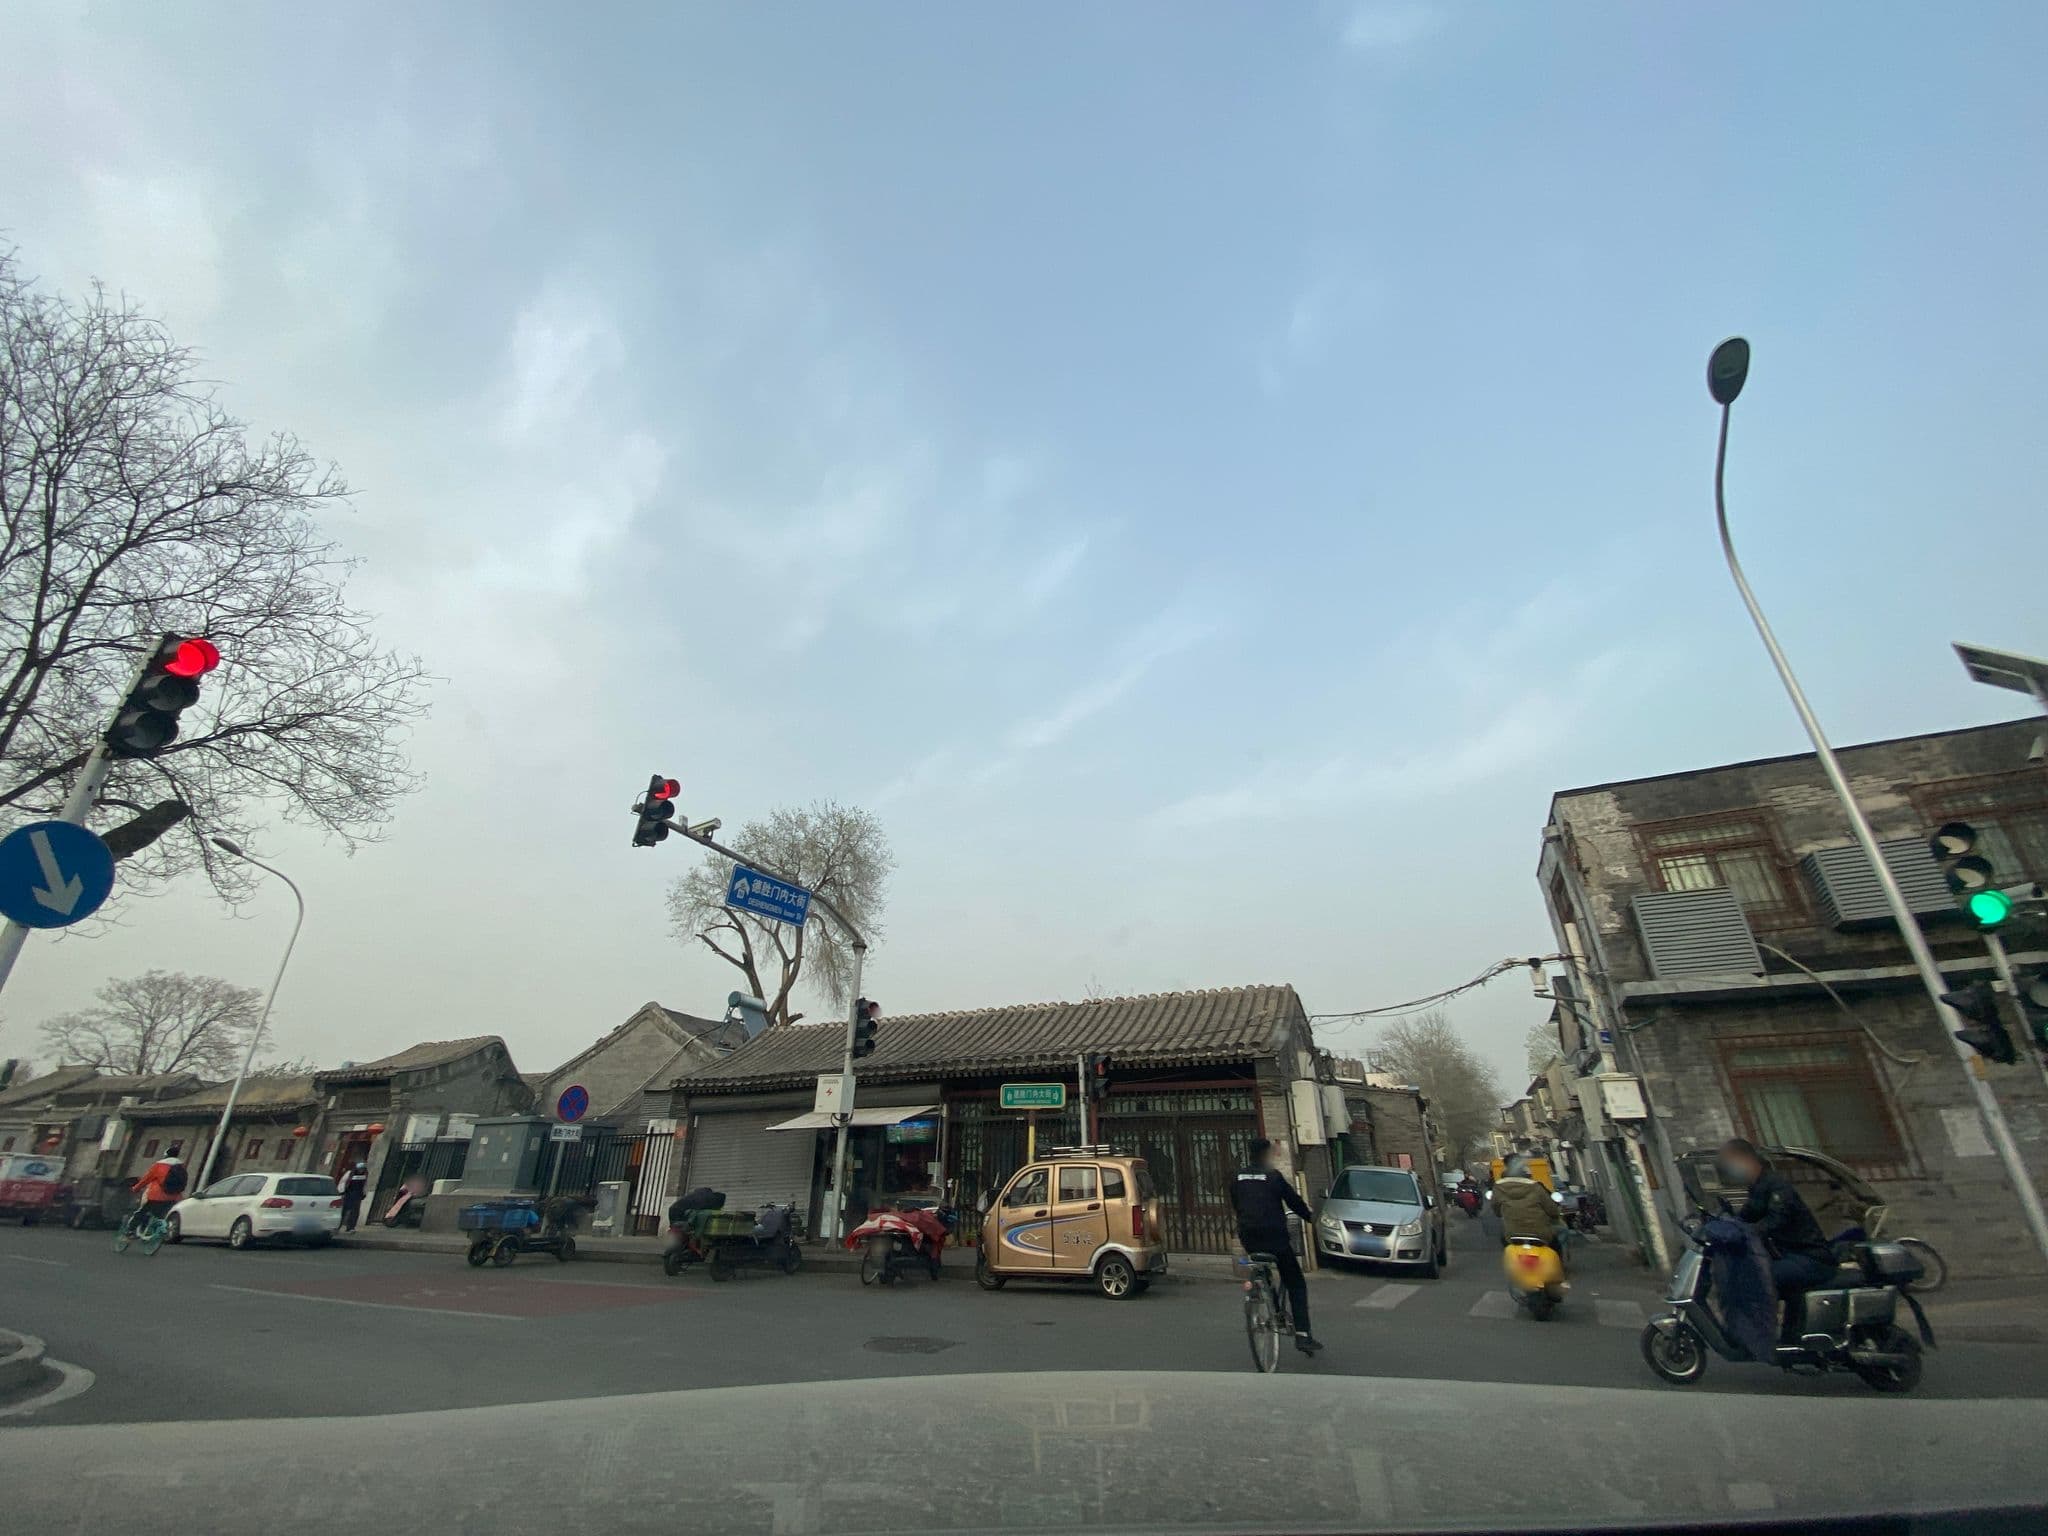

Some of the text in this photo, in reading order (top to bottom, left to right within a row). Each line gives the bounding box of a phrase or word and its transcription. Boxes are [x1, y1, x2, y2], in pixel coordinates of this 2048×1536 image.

[751, 878, 807, 909] 德胜门内大街
